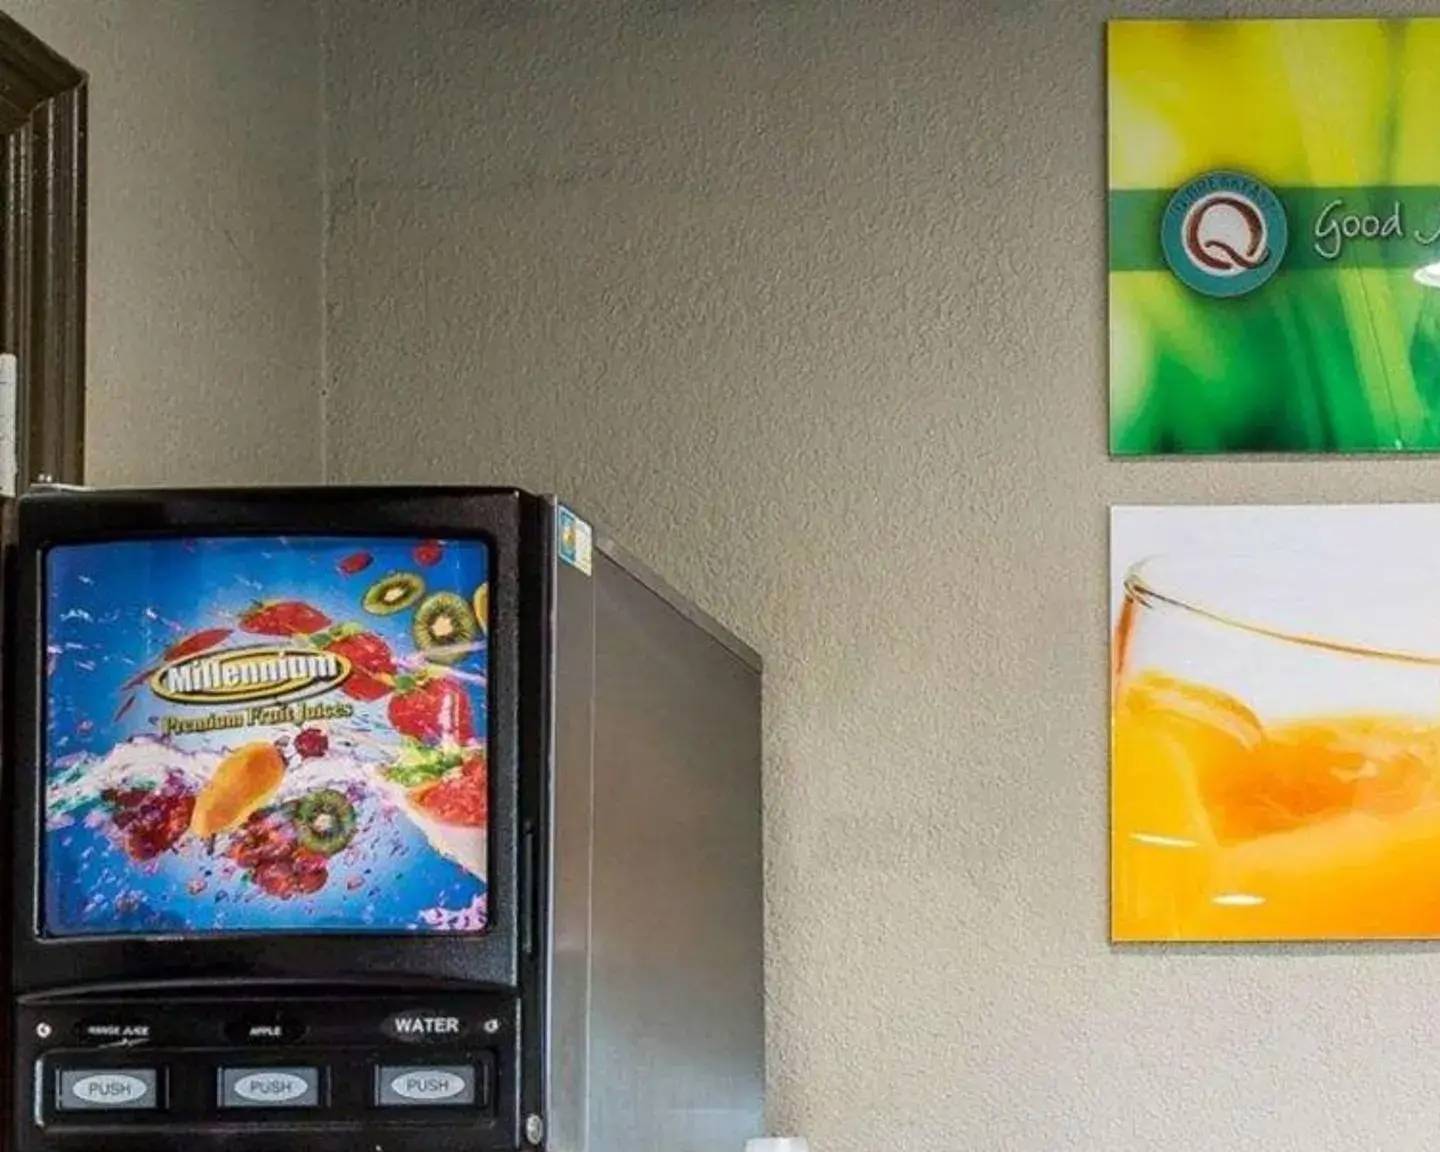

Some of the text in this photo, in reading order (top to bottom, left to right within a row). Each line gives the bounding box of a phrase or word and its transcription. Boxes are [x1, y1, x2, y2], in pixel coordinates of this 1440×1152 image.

[1186, 196, 1271, 270] Q
[1314, 200, 1403, 259] Good
[168, 651, 338, 693] Millennium
[162, 702, 354, 734] Premium Fruit Juices
[249, 1026, 281, 1036] APPLE
[394, 1017, 460, 1033] WATER
[88, 1083, 131, 1096] PUSH
[249, 1080, 293, 1094] PUSH
[406, 1078, 449, 1092] PUSH
